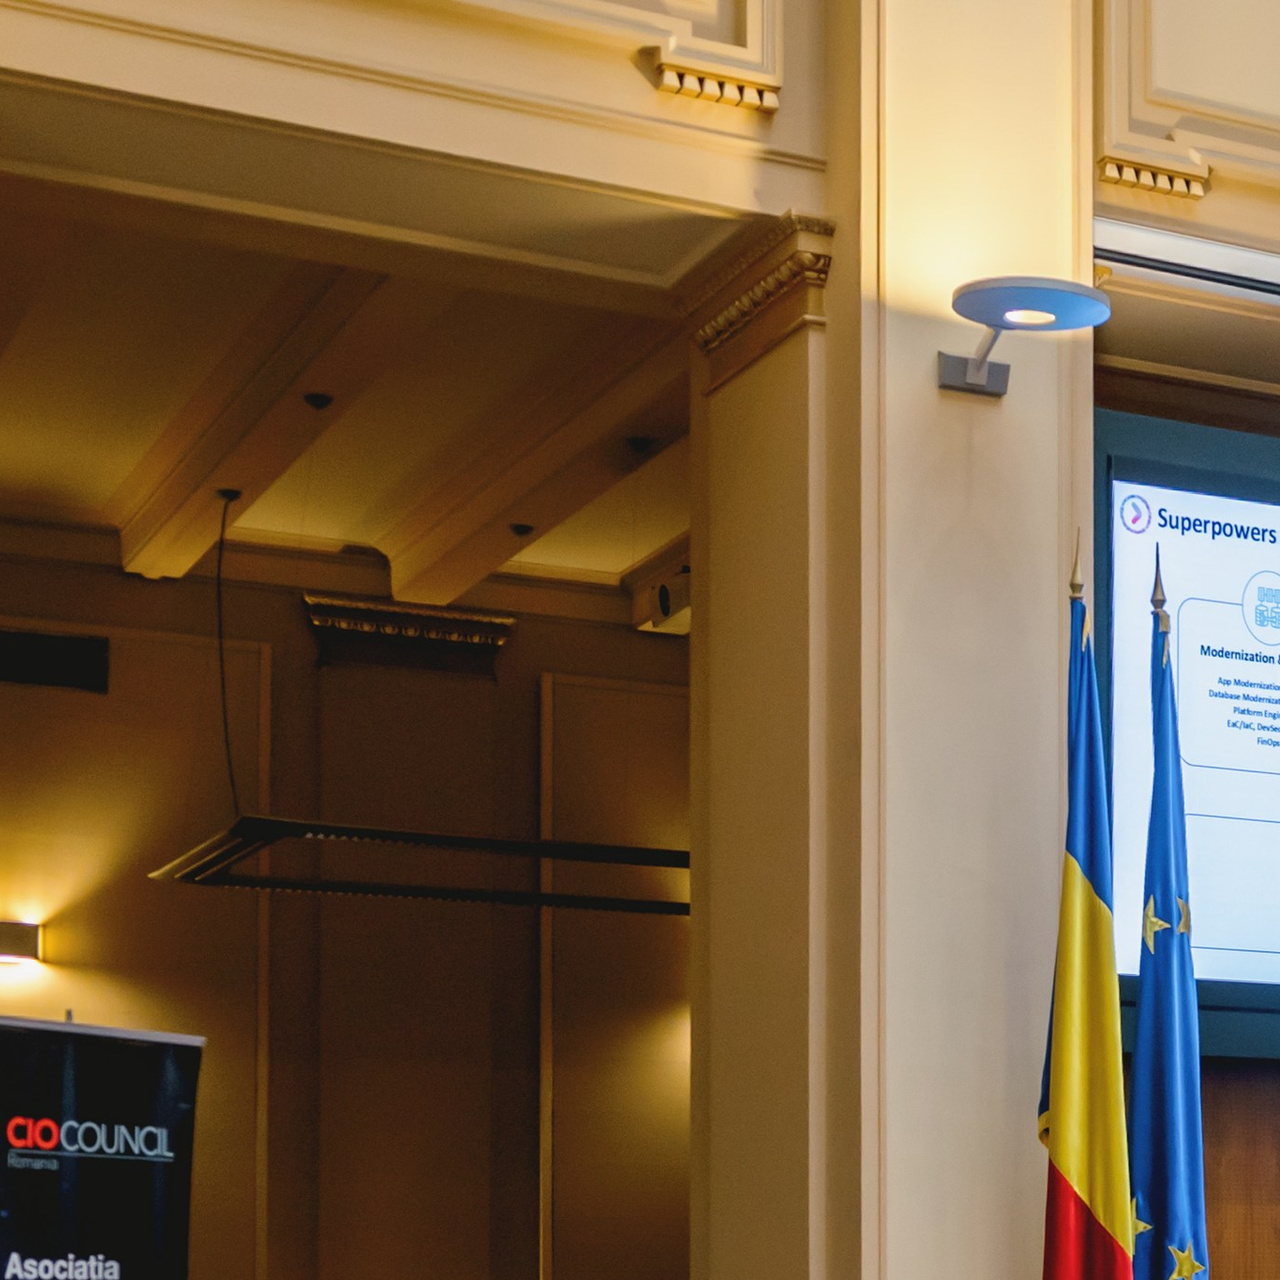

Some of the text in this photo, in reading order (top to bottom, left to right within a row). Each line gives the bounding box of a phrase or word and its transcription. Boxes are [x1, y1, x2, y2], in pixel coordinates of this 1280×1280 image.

[1158, 508, 1277, 544] Superpowers
[1200, 645, 1275, 664] Modernization
[1218, 677, 1232, 686] App
[1208, 690, 1240, 700] Database
[1234, 706, 1262, 717] Platform
[1257, 737, 1280, 747] FinOps
